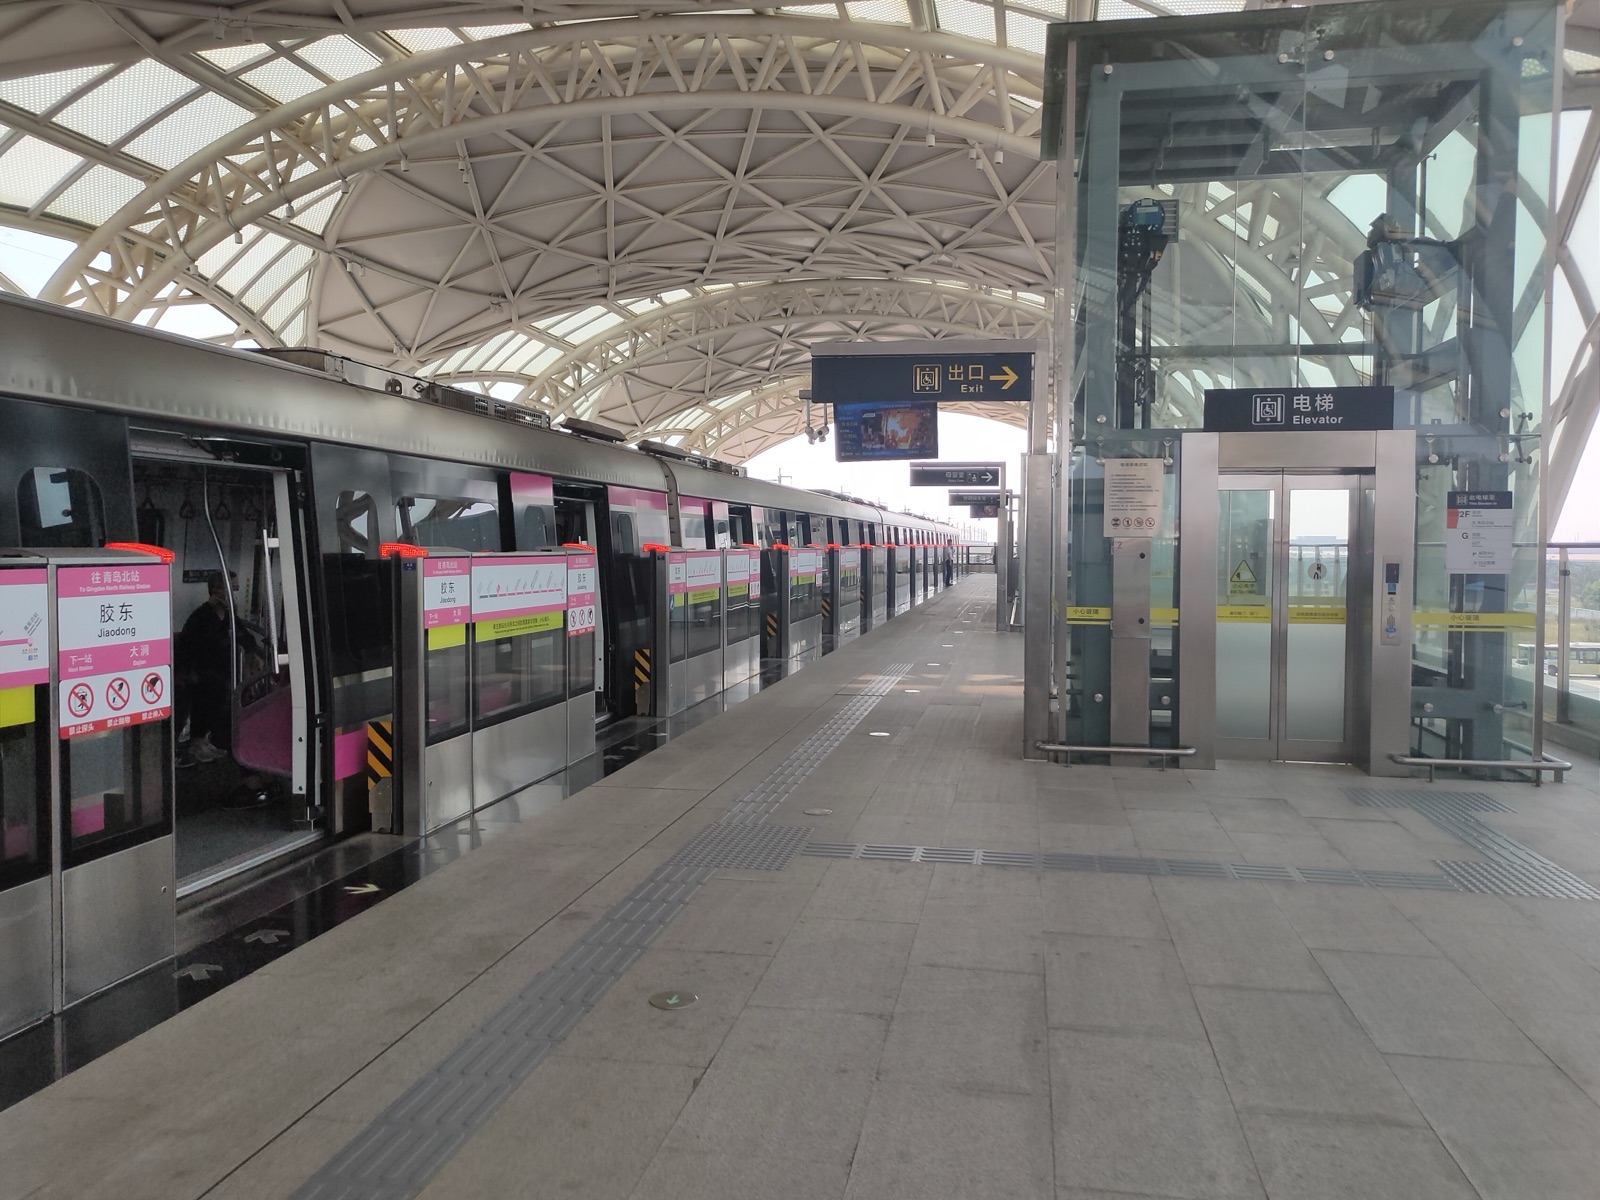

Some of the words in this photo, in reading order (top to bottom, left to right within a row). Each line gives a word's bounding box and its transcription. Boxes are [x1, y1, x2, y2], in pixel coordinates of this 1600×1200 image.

[948, 364, 984, 381] 出口
[960, 384, 984, 393] Exit
[1293, 393, 1334, 412] 电梯
[1292, 415, 1343, 425] Elevator
[945, 471, 965, 479] 母婴室
[91, 571, 101, 584] 往
[103, 570, 140, 584] 青岛北站
[440, 582, 455, 594] 胶东
[100, 602, 133, 623] 胶东
[98, 627, 136, 638] Jiaodong
[130, 644, 150, 658] 大涧
[70, 654, 92, 665] 下一站
[69, 723, 94, 736] 禁止探头
